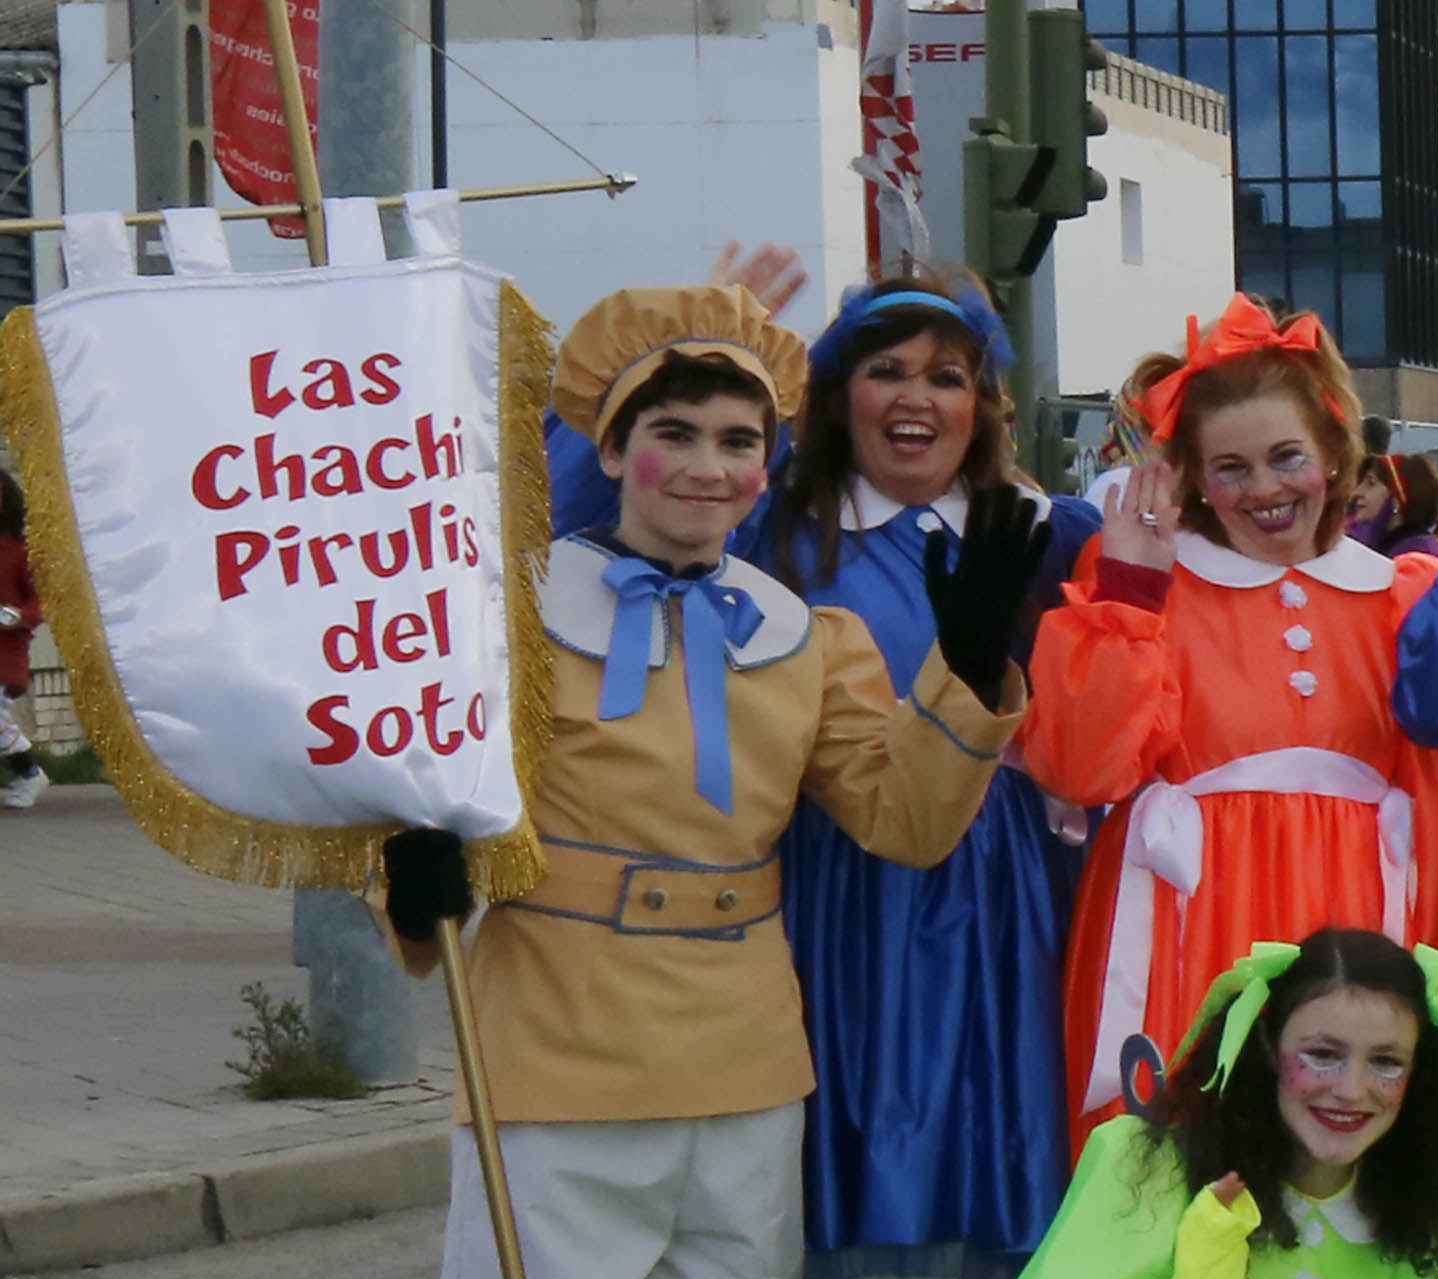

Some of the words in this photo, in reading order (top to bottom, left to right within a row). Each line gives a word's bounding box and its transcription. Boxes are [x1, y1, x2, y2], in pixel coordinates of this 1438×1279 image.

[249, 350, 402, 418] Las
[191, 414, 466, 510] Chachi
[215, 502, 479, 602] Pirulis
[322, 588, 450, 674] del
